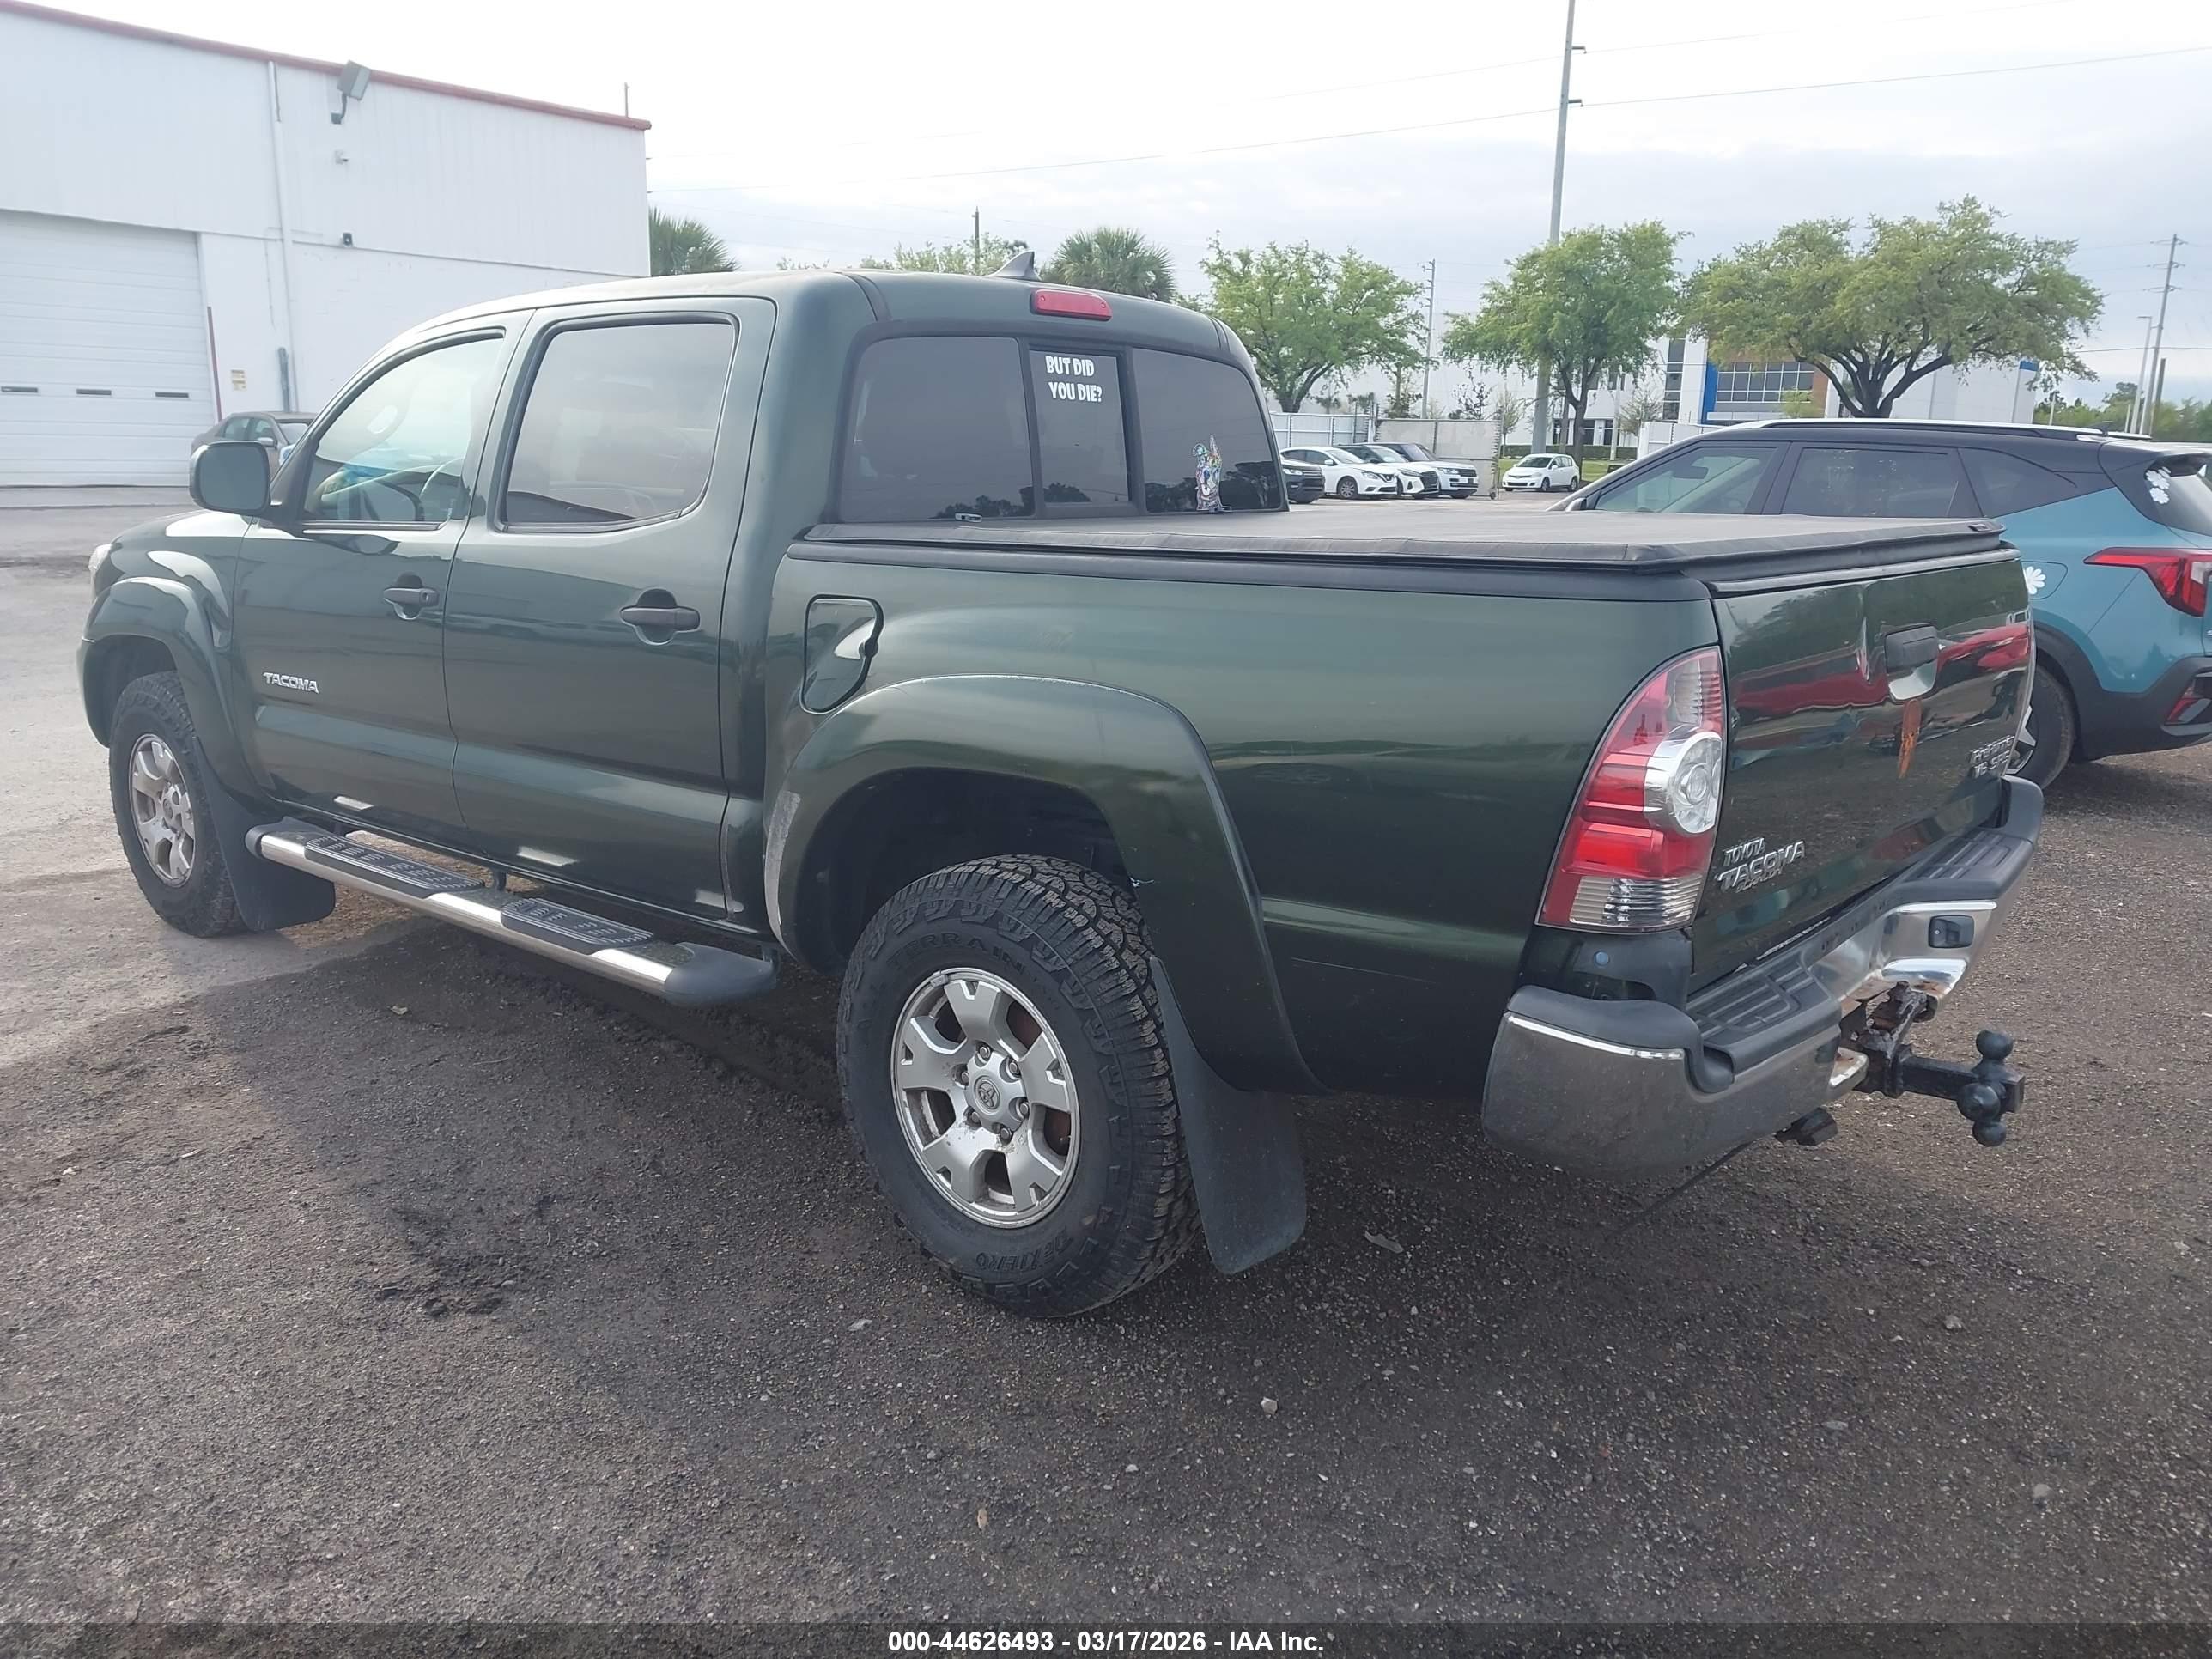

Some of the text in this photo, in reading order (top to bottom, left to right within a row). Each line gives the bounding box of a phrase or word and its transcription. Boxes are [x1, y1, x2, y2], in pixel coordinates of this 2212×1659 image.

[1045, 356, 1095, 377] BUT DID
[1048, 381, 1103, 403] YOU DIE?
[263, 672, 319, 694] TACOMA
[1723, 837, 1765, 866] TOYOTA
[1717, 841, 1805, 890] TACOMA
